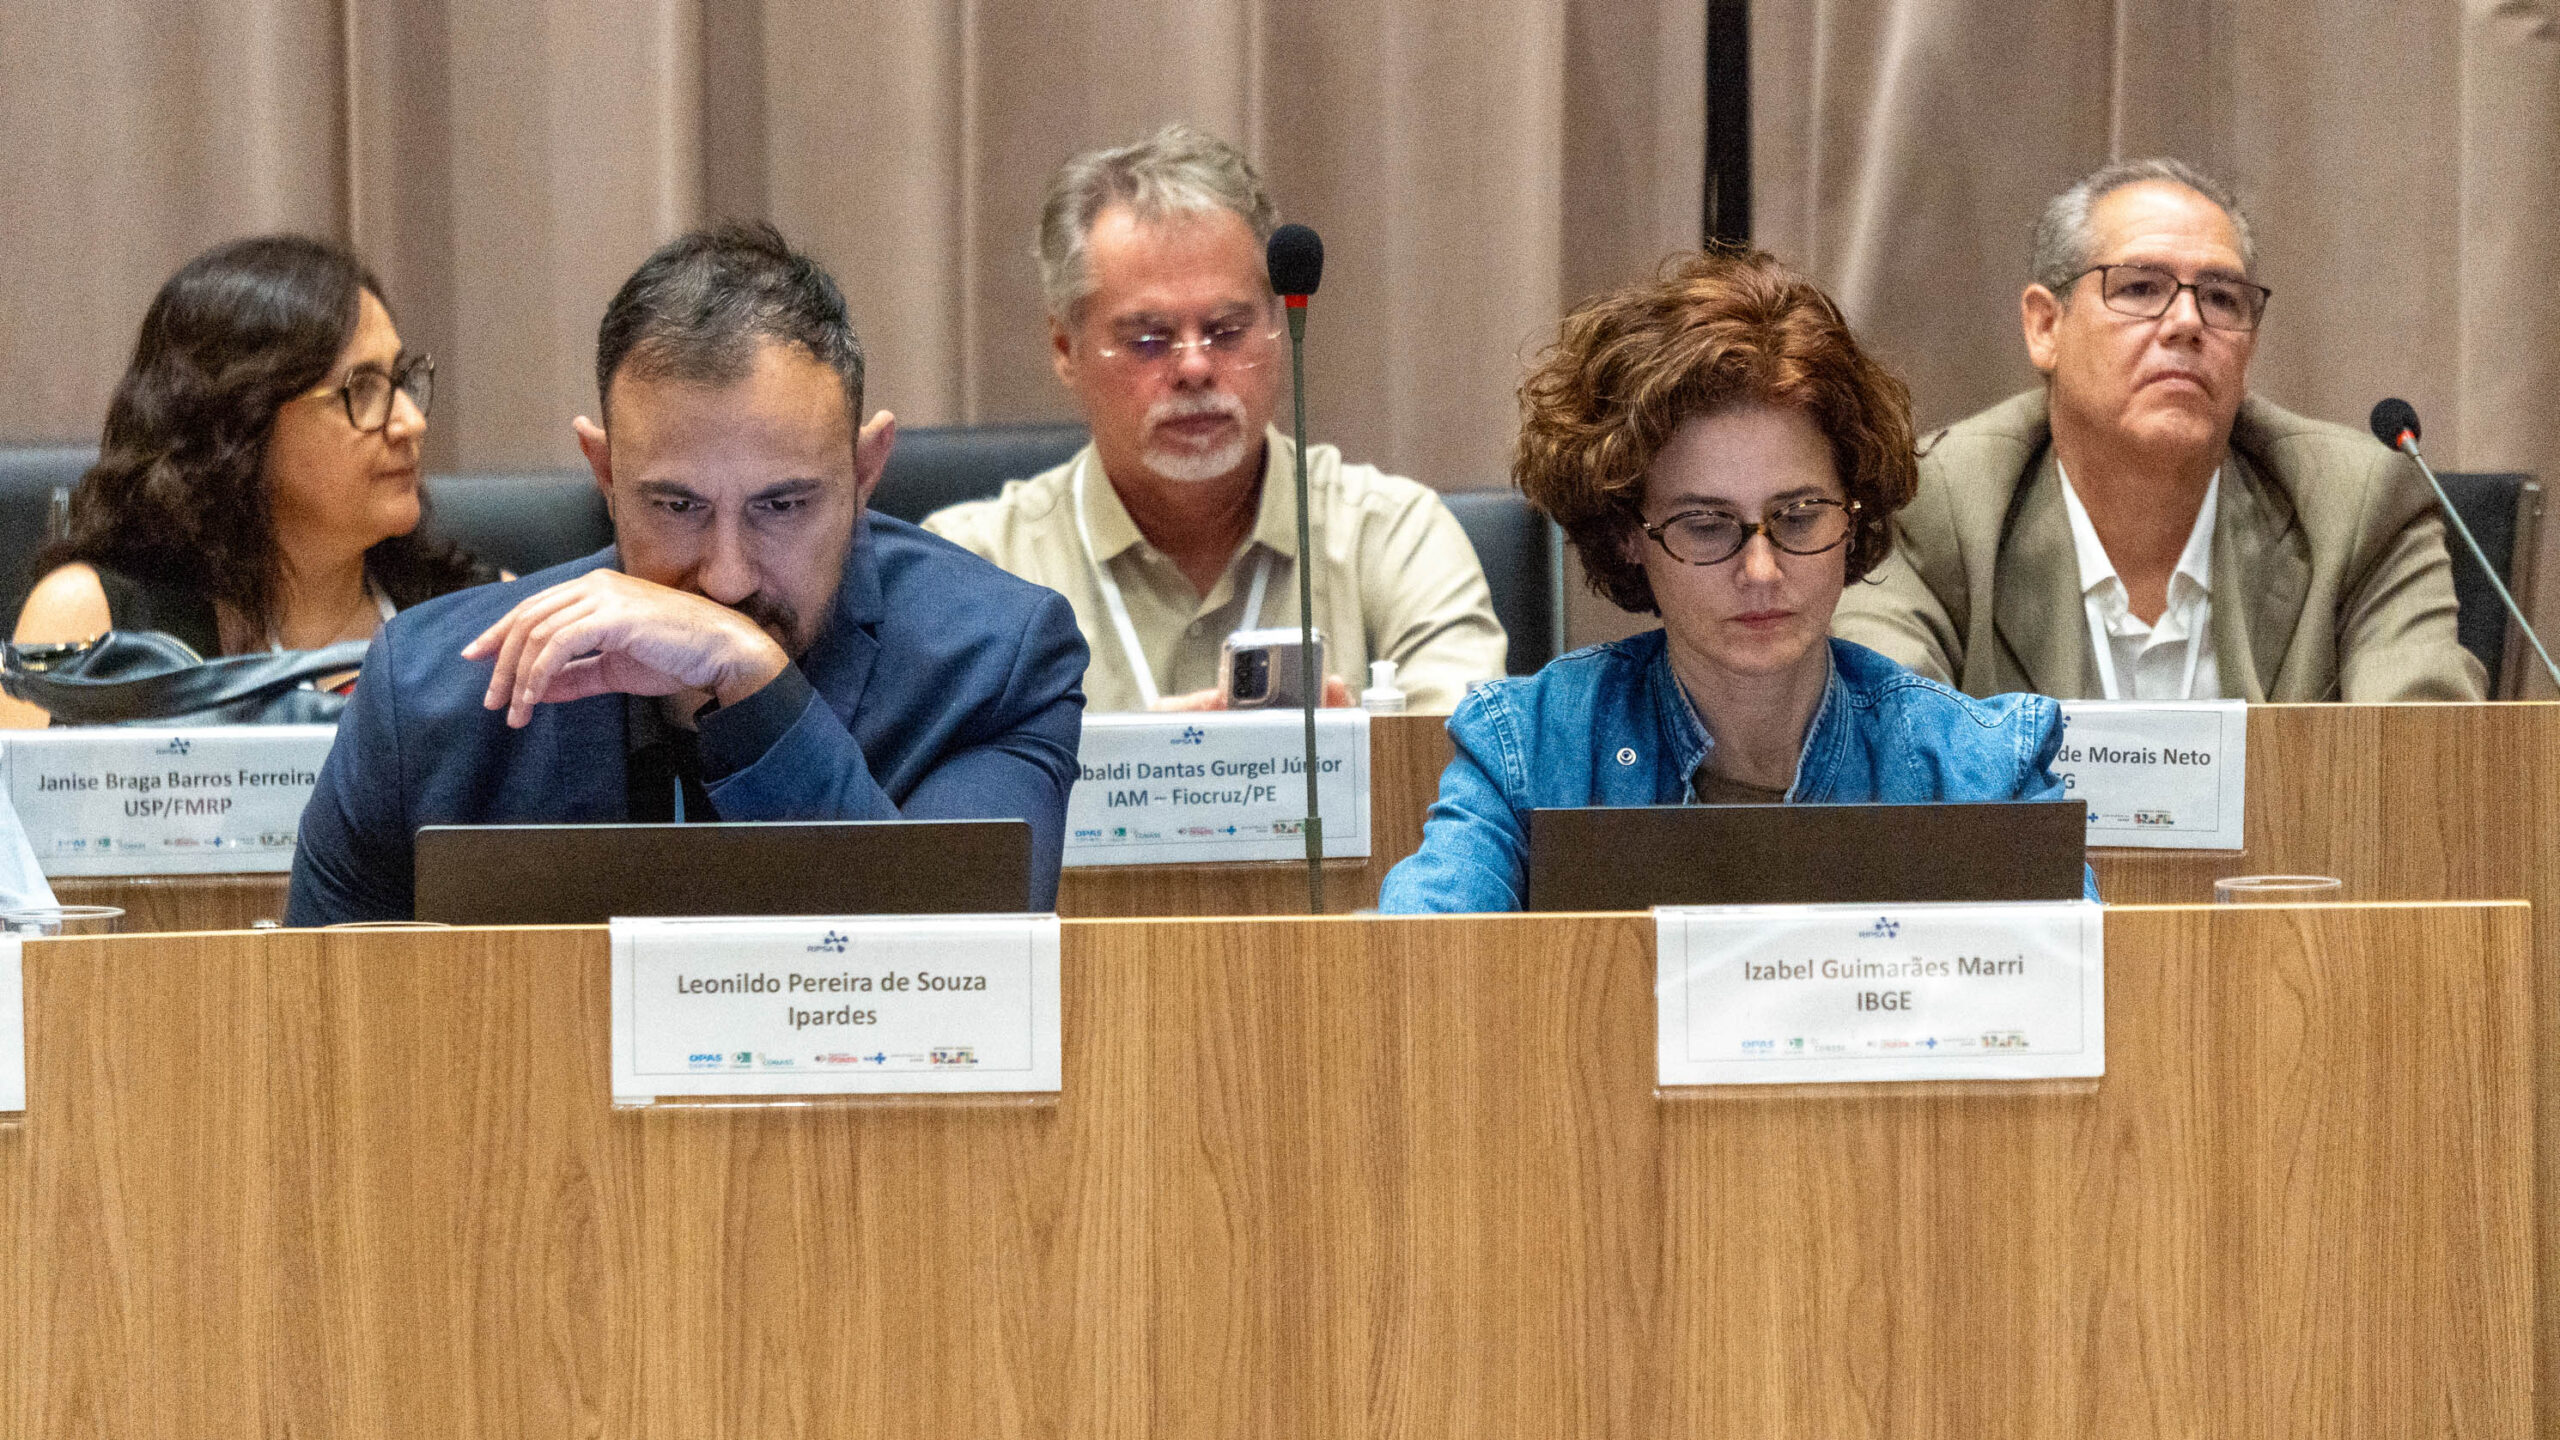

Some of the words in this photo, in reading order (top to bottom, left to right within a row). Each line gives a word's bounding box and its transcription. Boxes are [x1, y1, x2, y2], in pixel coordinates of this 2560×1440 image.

[2058, 745, 2082, 763] de
[2089, 746, 2157, 765] Morais
[2163, 748, 2211, 766] Neto
[38, 773, 99, 792] Janise
[106, 772, 162, 793] Braga
[168, 770, 232, 788] Barros
[238, 768, 316, 787] Ferreira
[1079, 762, 1131, 781] baldi
[1137, 758, 1206, 780] Dantas
[1211, 758, 1276, 783] Gurgel
[2056, 773, 2076, 790] G
[124, 797, 233, 819] USP/FMRP
[1108, 790, 1148, 808] IAM
[1172, 784, 1277, 807] Fiocruz/PE
[1745, 959, 1814, 982] Izabel
[1821, 956, 1950, 980] Guimarães
[1958, 954, 2025, 976] Marri
[677, 971, 781, 994] Leonildo
[788, 970, 873, 993] Pereira
[881, 969, 911, 992] de
[918, 969, 987, 992] Souza
[1857, 992, 1912, 1012] IBGE
[788, 1004, 878, 1031] Ipardes
